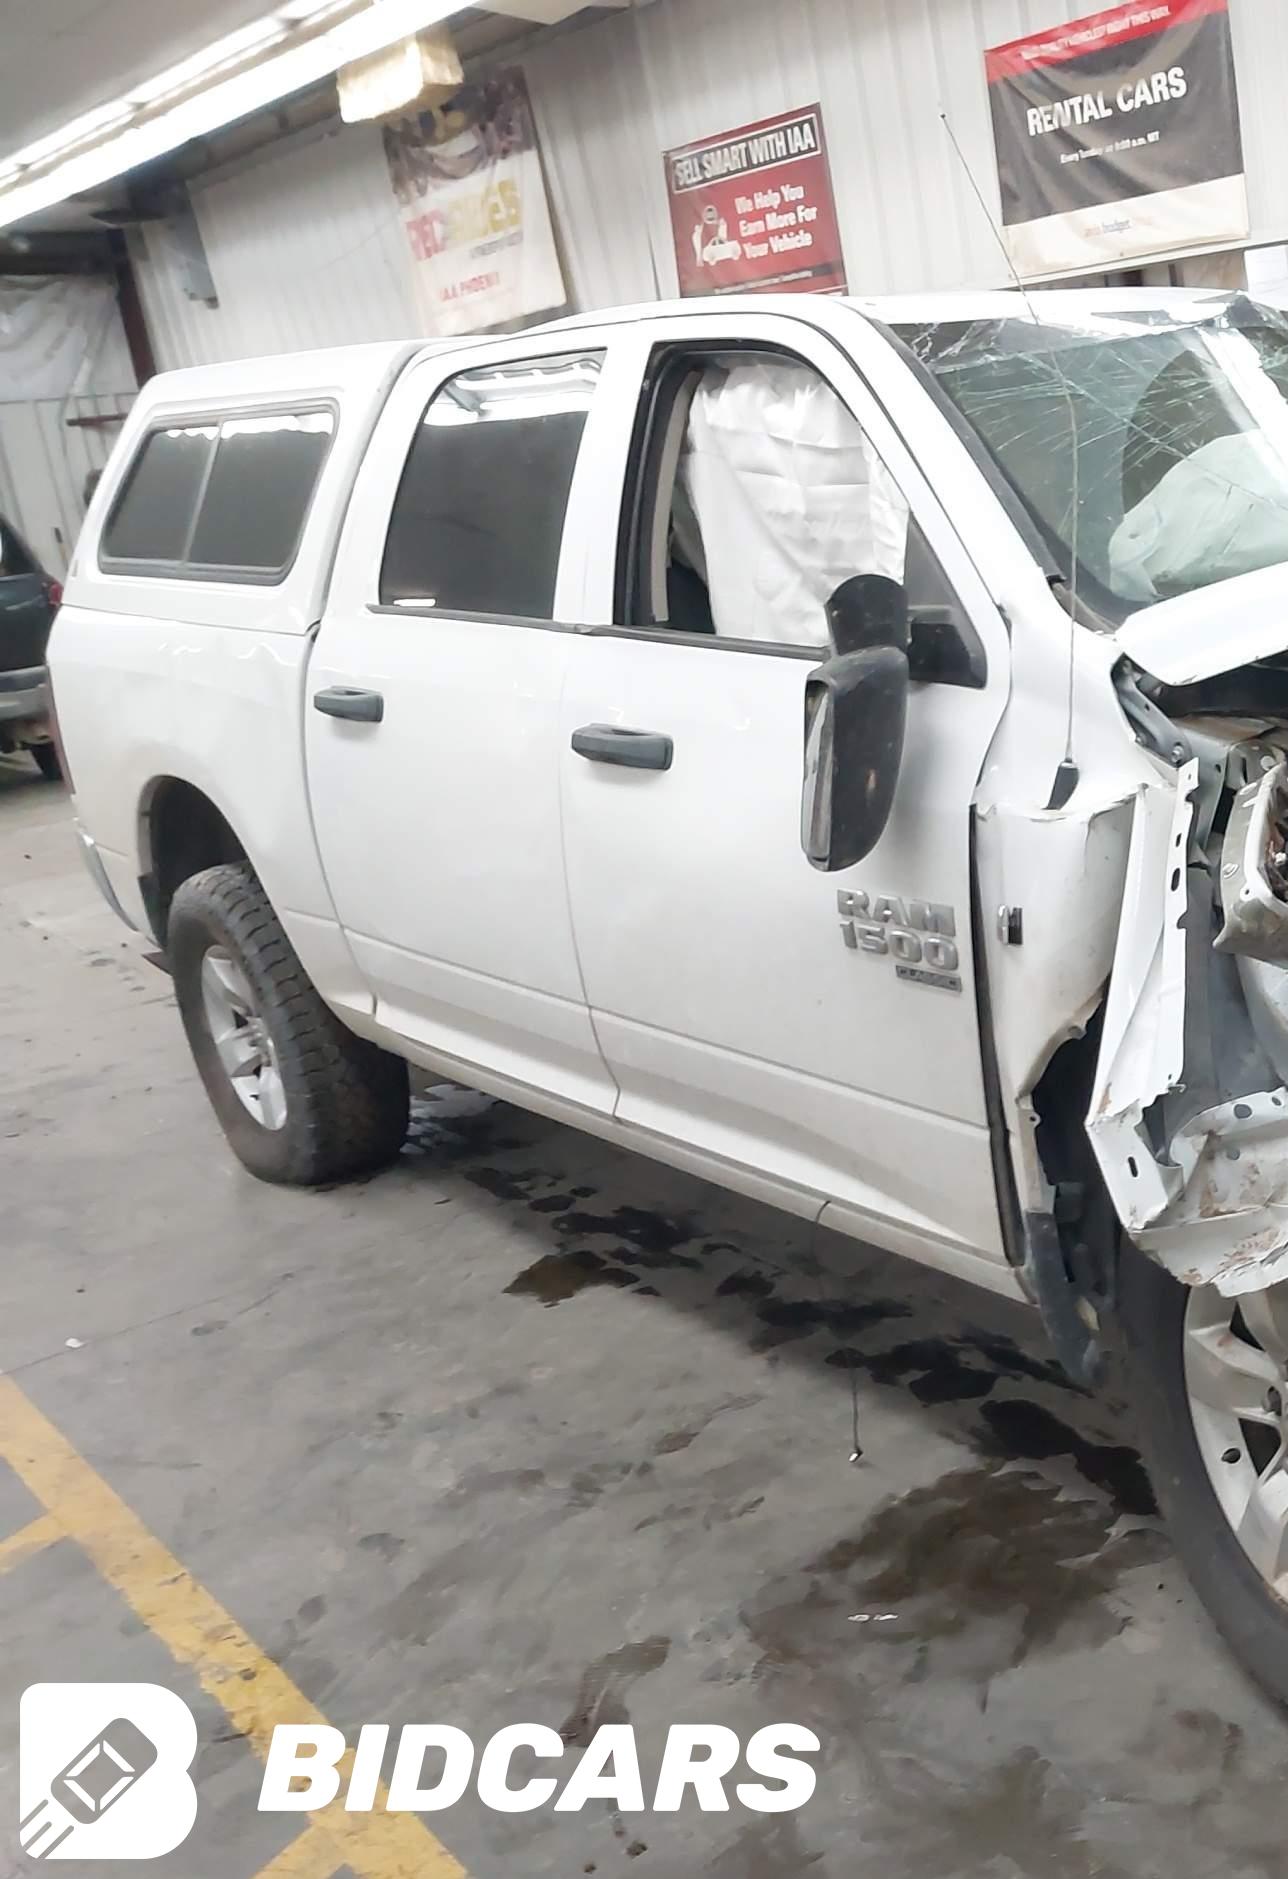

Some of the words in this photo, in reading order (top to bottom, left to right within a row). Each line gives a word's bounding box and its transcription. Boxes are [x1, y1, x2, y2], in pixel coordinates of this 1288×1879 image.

[1026, 91, 1113, 137] RENTAL
[1116, 67, 1188, 113] CARS
[675, 157, 703, 187] SELL
[702, 142, 748, 177] SMART
[748, 131, 787, 165] WITH
[787, 122, 816, 155] IAA
[739, 219, 765, 237] Earn
[765, 211, 796, 231] More
[796, 204, 818, 222] For
[753, 188, 781, 209] Help
[780, 184, 805, 202] You
[769, 229, 813, 253] Vehicle
[837, 888, 956, 938] RAM
[840, 920, 959, 971] 1500
